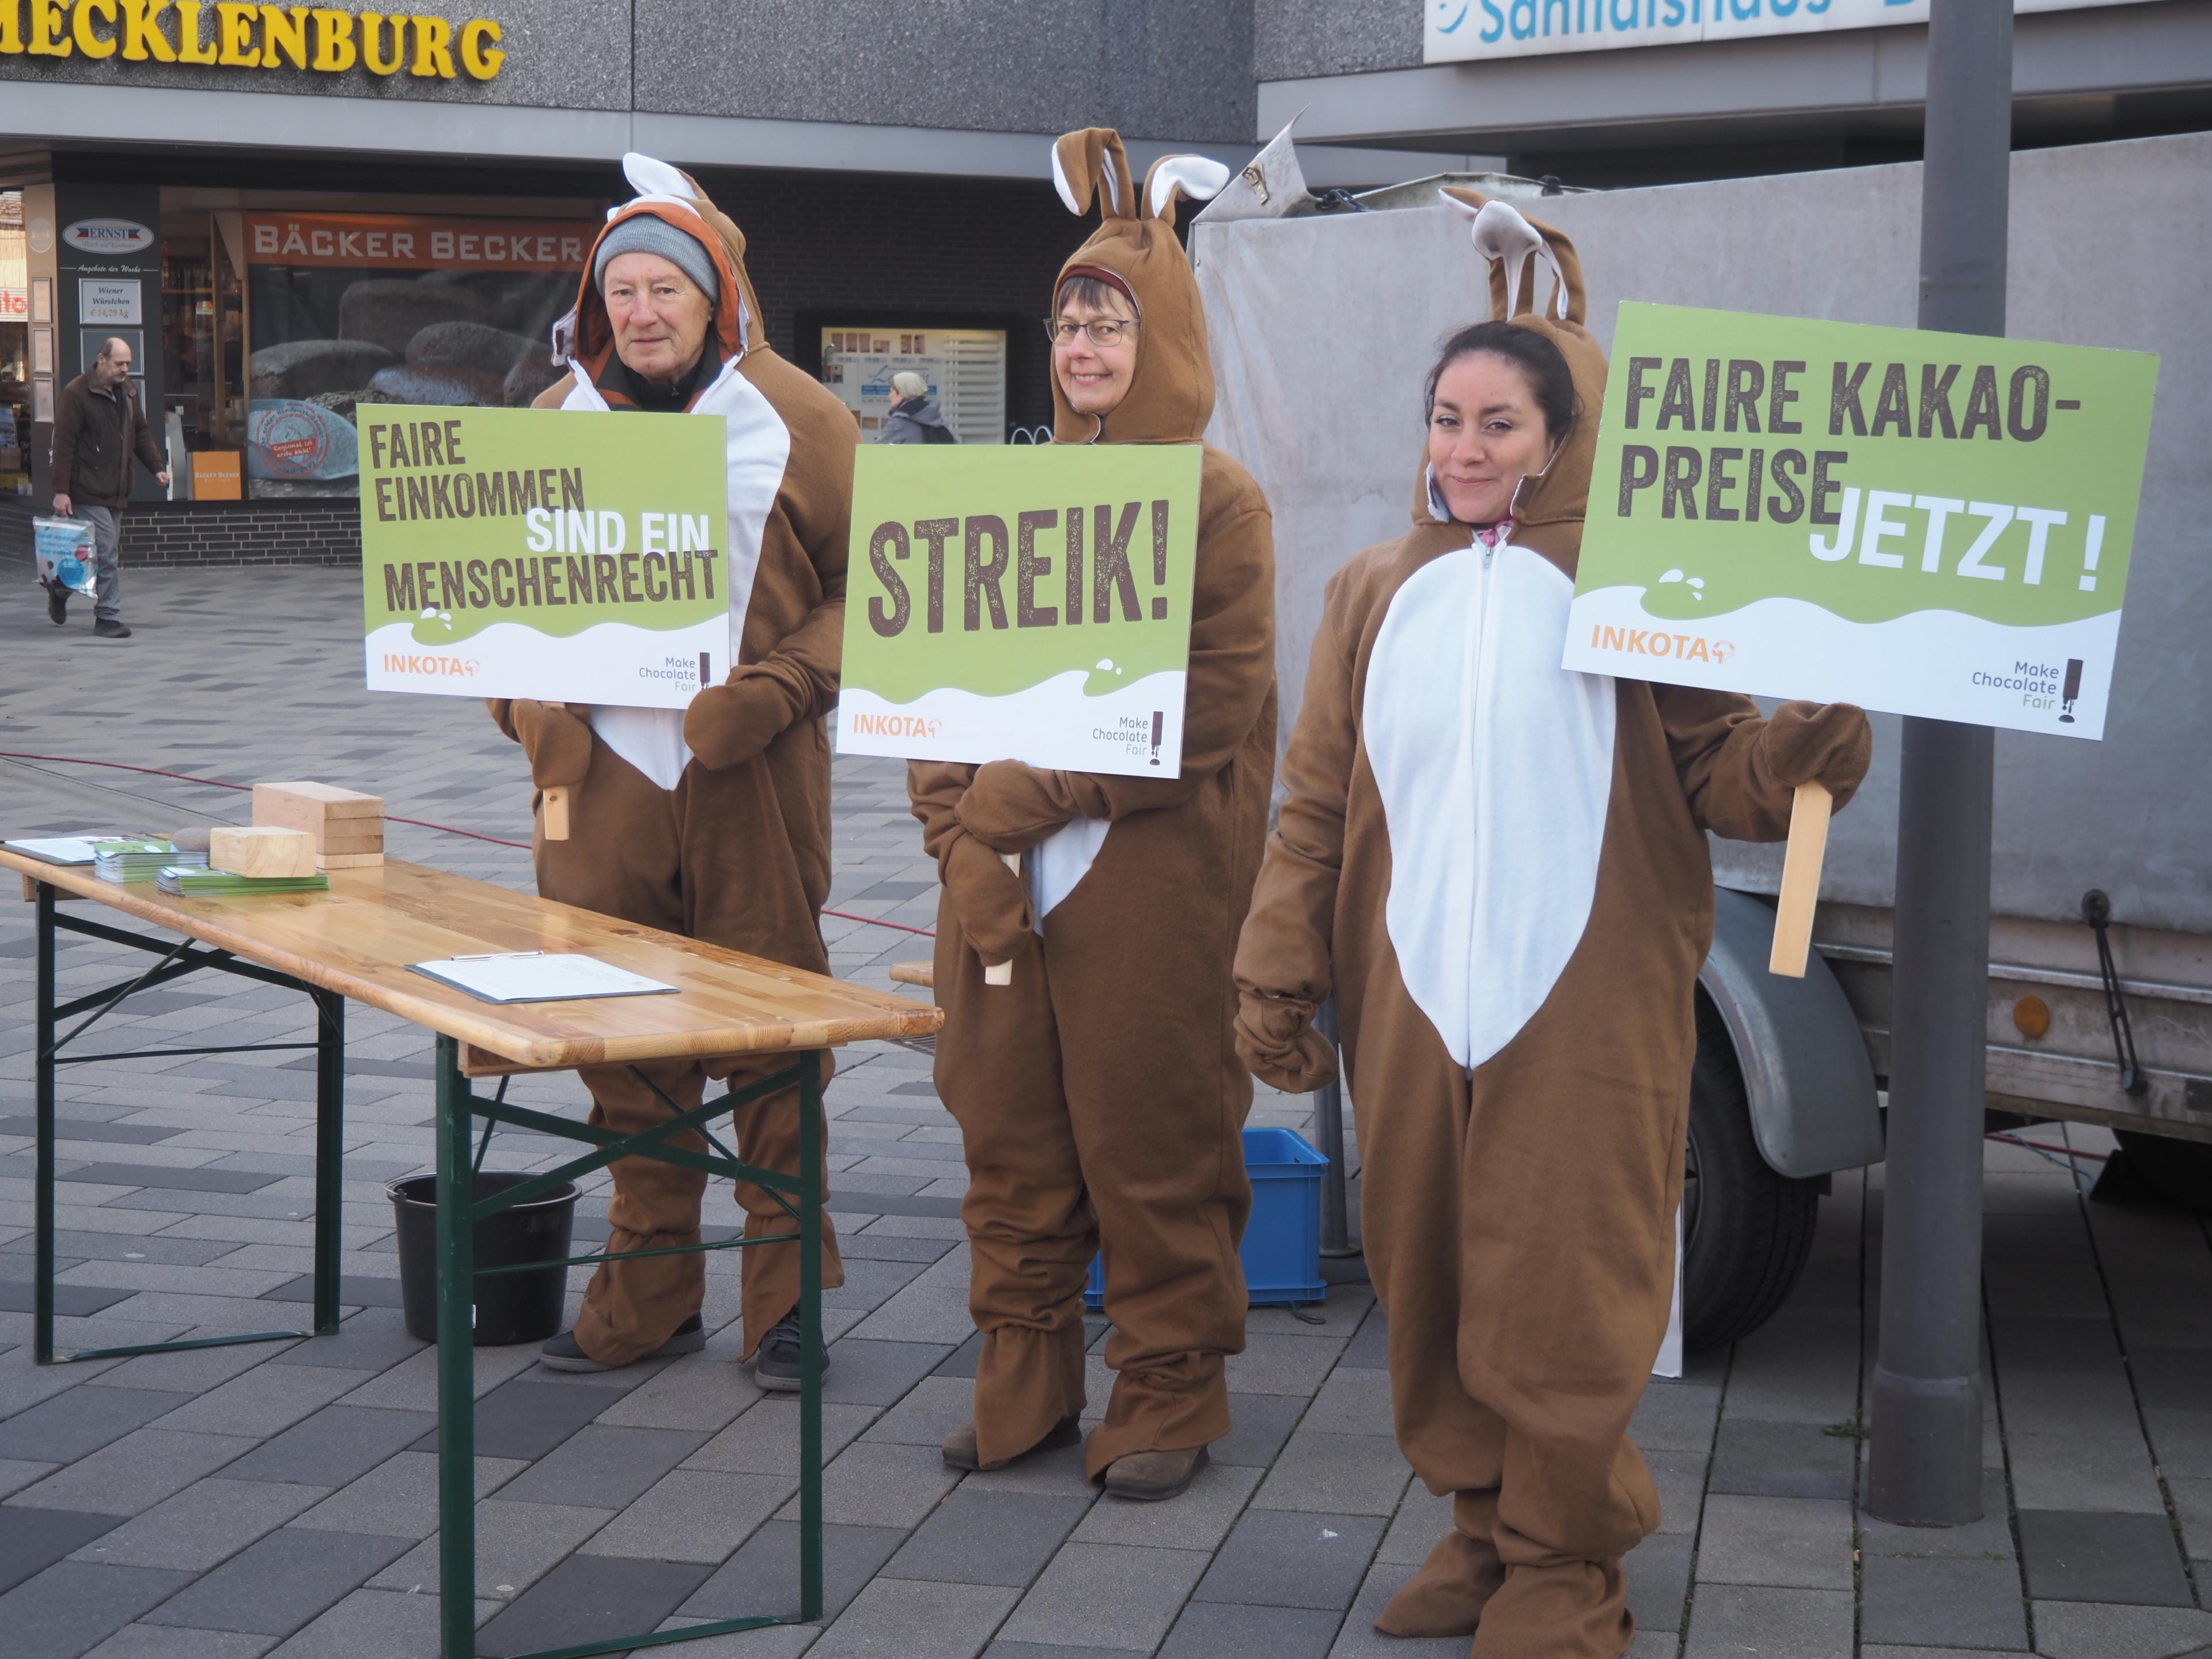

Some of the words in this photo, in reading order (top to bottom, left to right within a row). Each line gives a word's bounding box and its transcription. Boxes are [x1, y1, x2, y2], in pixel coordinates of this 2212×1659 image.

[90, 228, 127, 238] ERNST
[255, 224, 415, 259] BÄCKER
[431, 232, 582, 262] BECKER
[78, 264, 107, 274] Angebote
[121, 265, 141, 273] Woche
[90, 309, 96, 317] €
[120, 309, 129, 319] kg
[1624, 357, 1806, 435] FAIRE
[1828, 361, 2081, 442] KAKAO-
[273, 441, 302, 452] Regional
[276, 449, 293, 458] erste
[294, 446, 312, 455] Wahl!
[369, 420, 466, 469] FAIRE
[1617, 444, 1849, 525] PREISE
[375, 467, 585, 522] EINKOMMEN
[527, 507, 626, 555] SIND
[642, 512, 709, 557] EIN
[868, 499, 1169, 638] STREIK!
[384, 550, 718, 612] MENSCHENRECHT
[1590, 625, 1710, 663] INKOTA
[384, 654, 464, 677] INKOTA
[665, 657, 696, 669] Make
[2014, 661, 2060, 679] Make
[639, 668, 696, 680] Chocolate
[675, 681, 696, 692] Fair
[1971, 671, 2058, 696] Chocolate
[2022, 695, 2056, 711] Fair
[853, 714, 927, 738] INKOTA
[1119, 717, 1149, 730] Make
[1092, 728, 1147, 743] Chocolate
[1126, 744, 1147, 756] Fair
